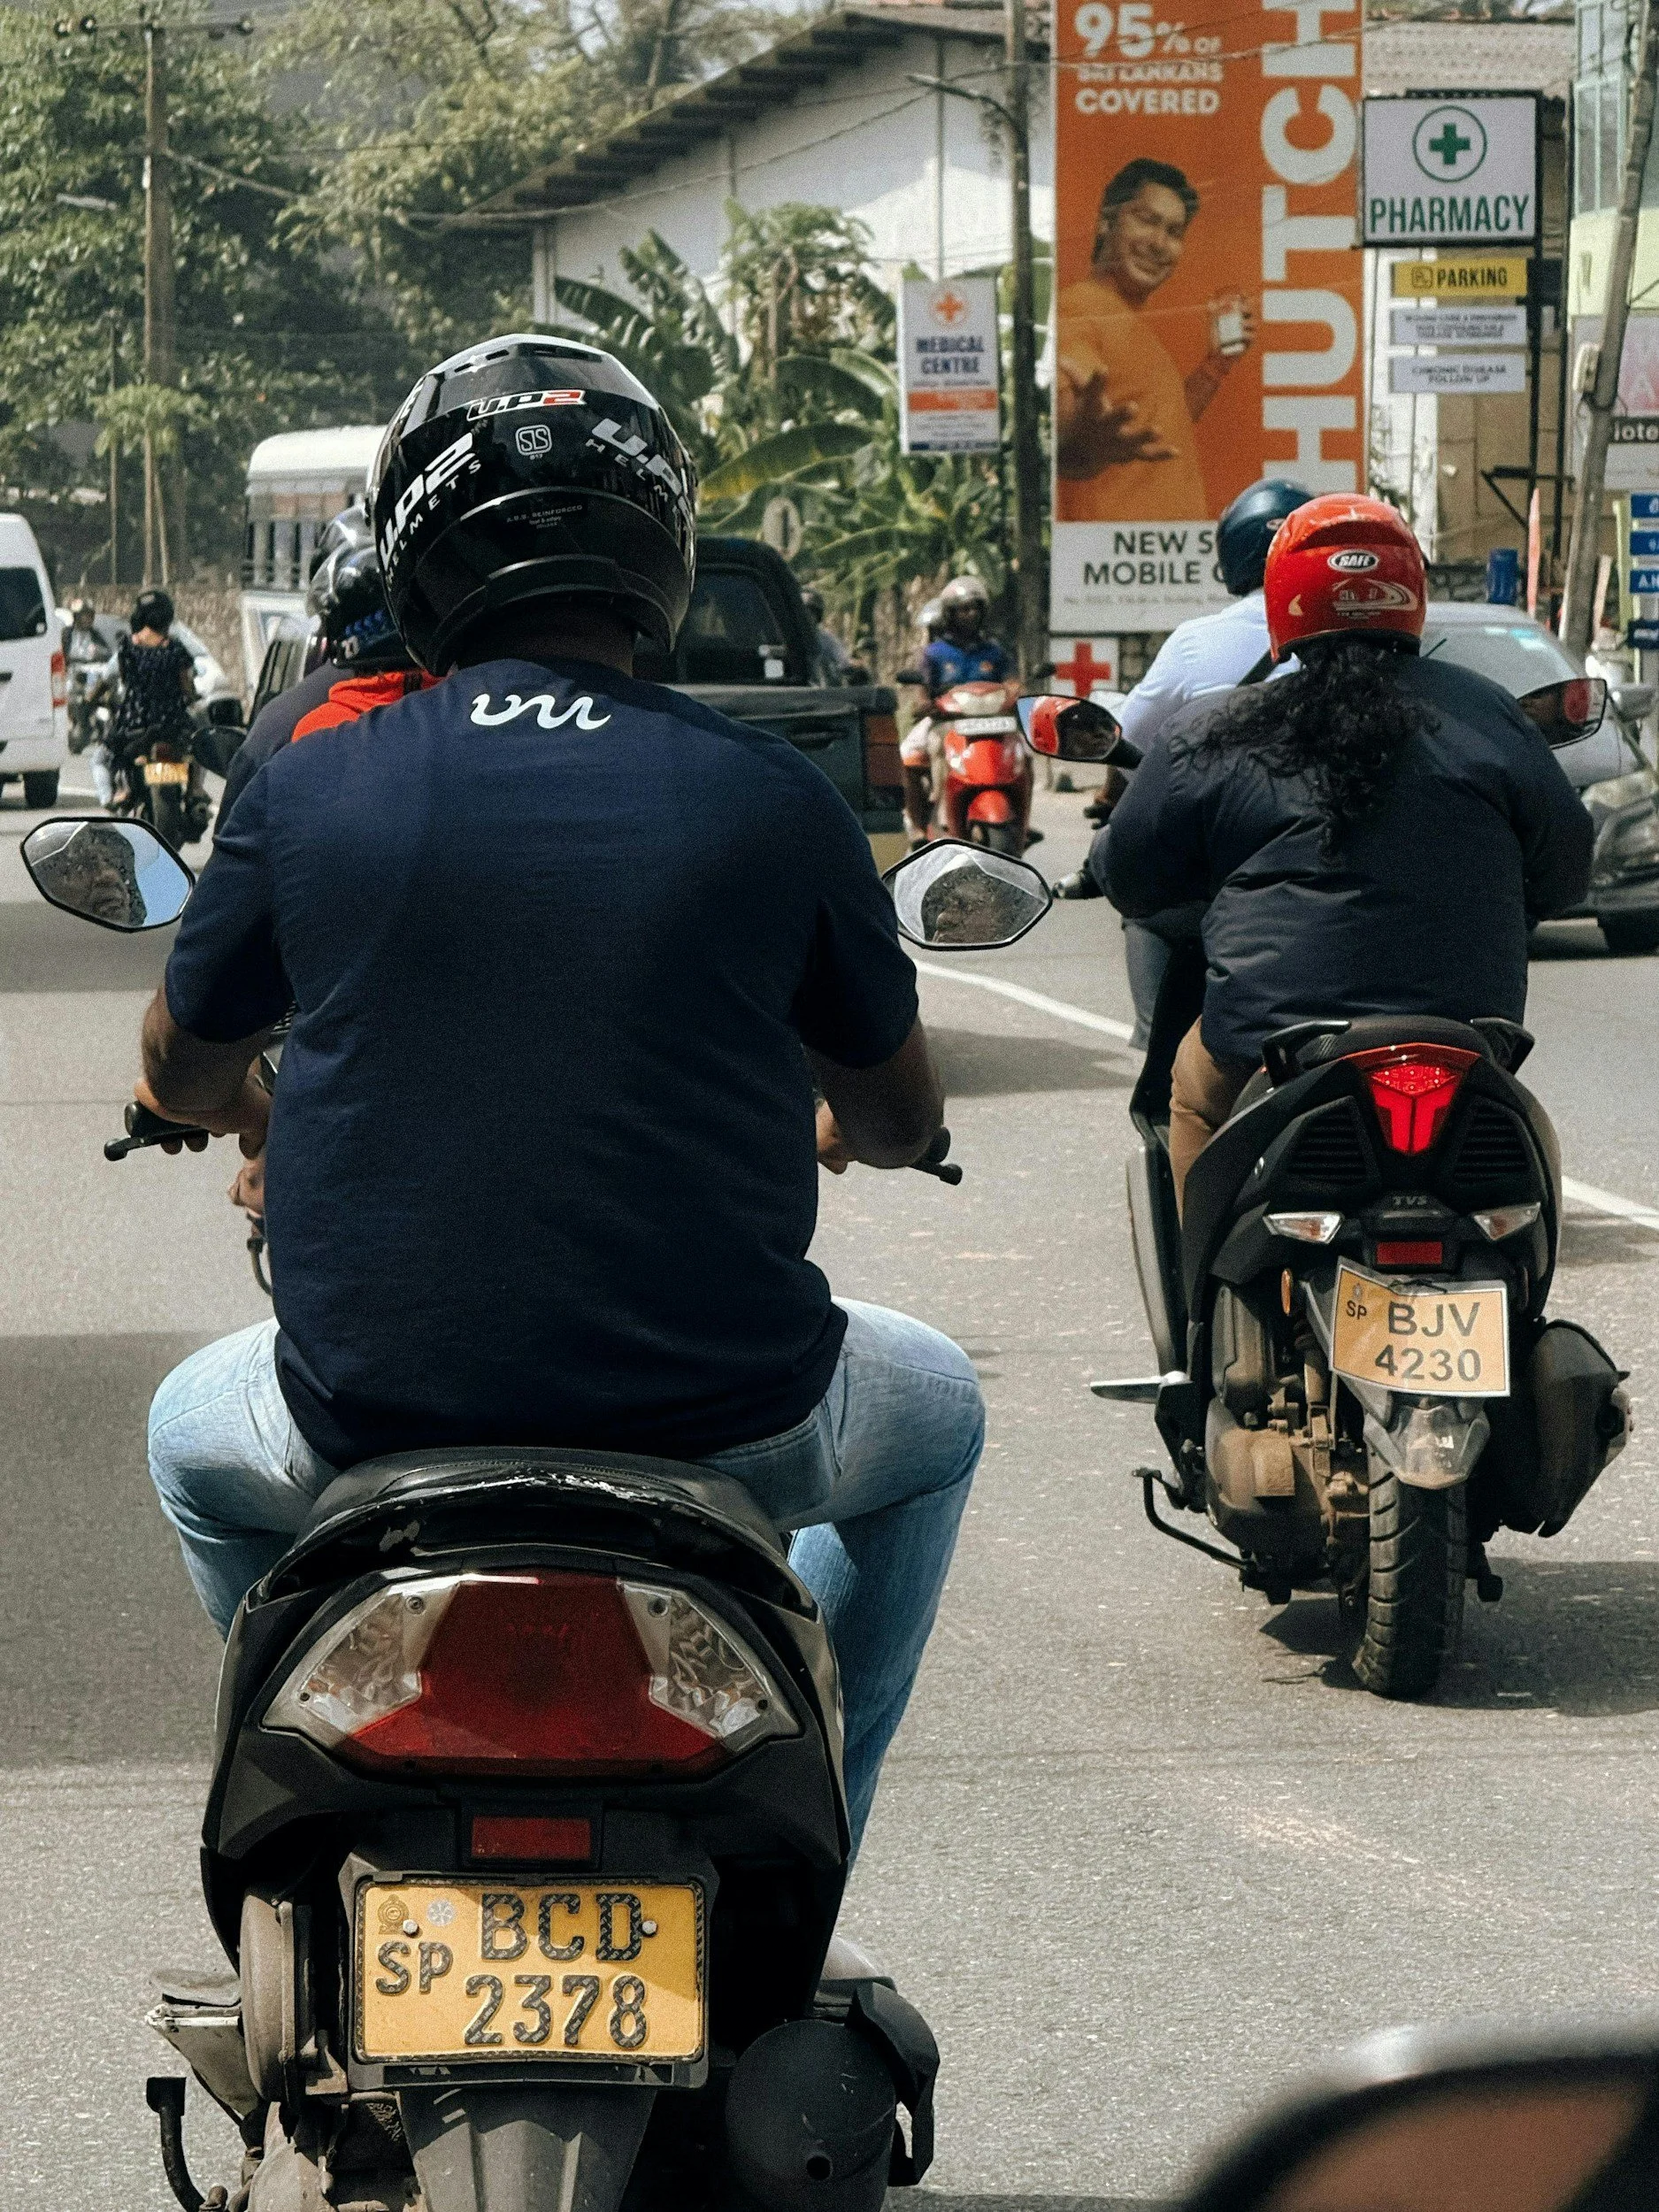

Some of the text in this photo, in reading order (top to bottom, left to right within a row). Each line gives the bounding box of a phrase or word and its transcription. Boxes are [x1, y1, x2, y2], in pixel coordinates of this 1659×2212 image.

[1075, 88, 1220, 115] COVERED
[1370, 194, 1530, 234] PHARMACY
[1262, 0, 1356, 494] HUTCH
[1437, 267, 1509, 288] PARKING
[917, 335, 984, 353] MEDICAL
[921, 357, 979, 373] CENTRE
[1113, 530, 1188, 556] NEW
[1084, 560, 1202, 586] MOBILE
[1391, 1194, 1428, 1206] TVS
[1346, 1300, 1481, 1338] SP BJV
[1374, 1343, 1482, 1383] 4230
[375, 1892, 643, 1995] SP BCD
[464, 1973, 649, 2049] 2378
